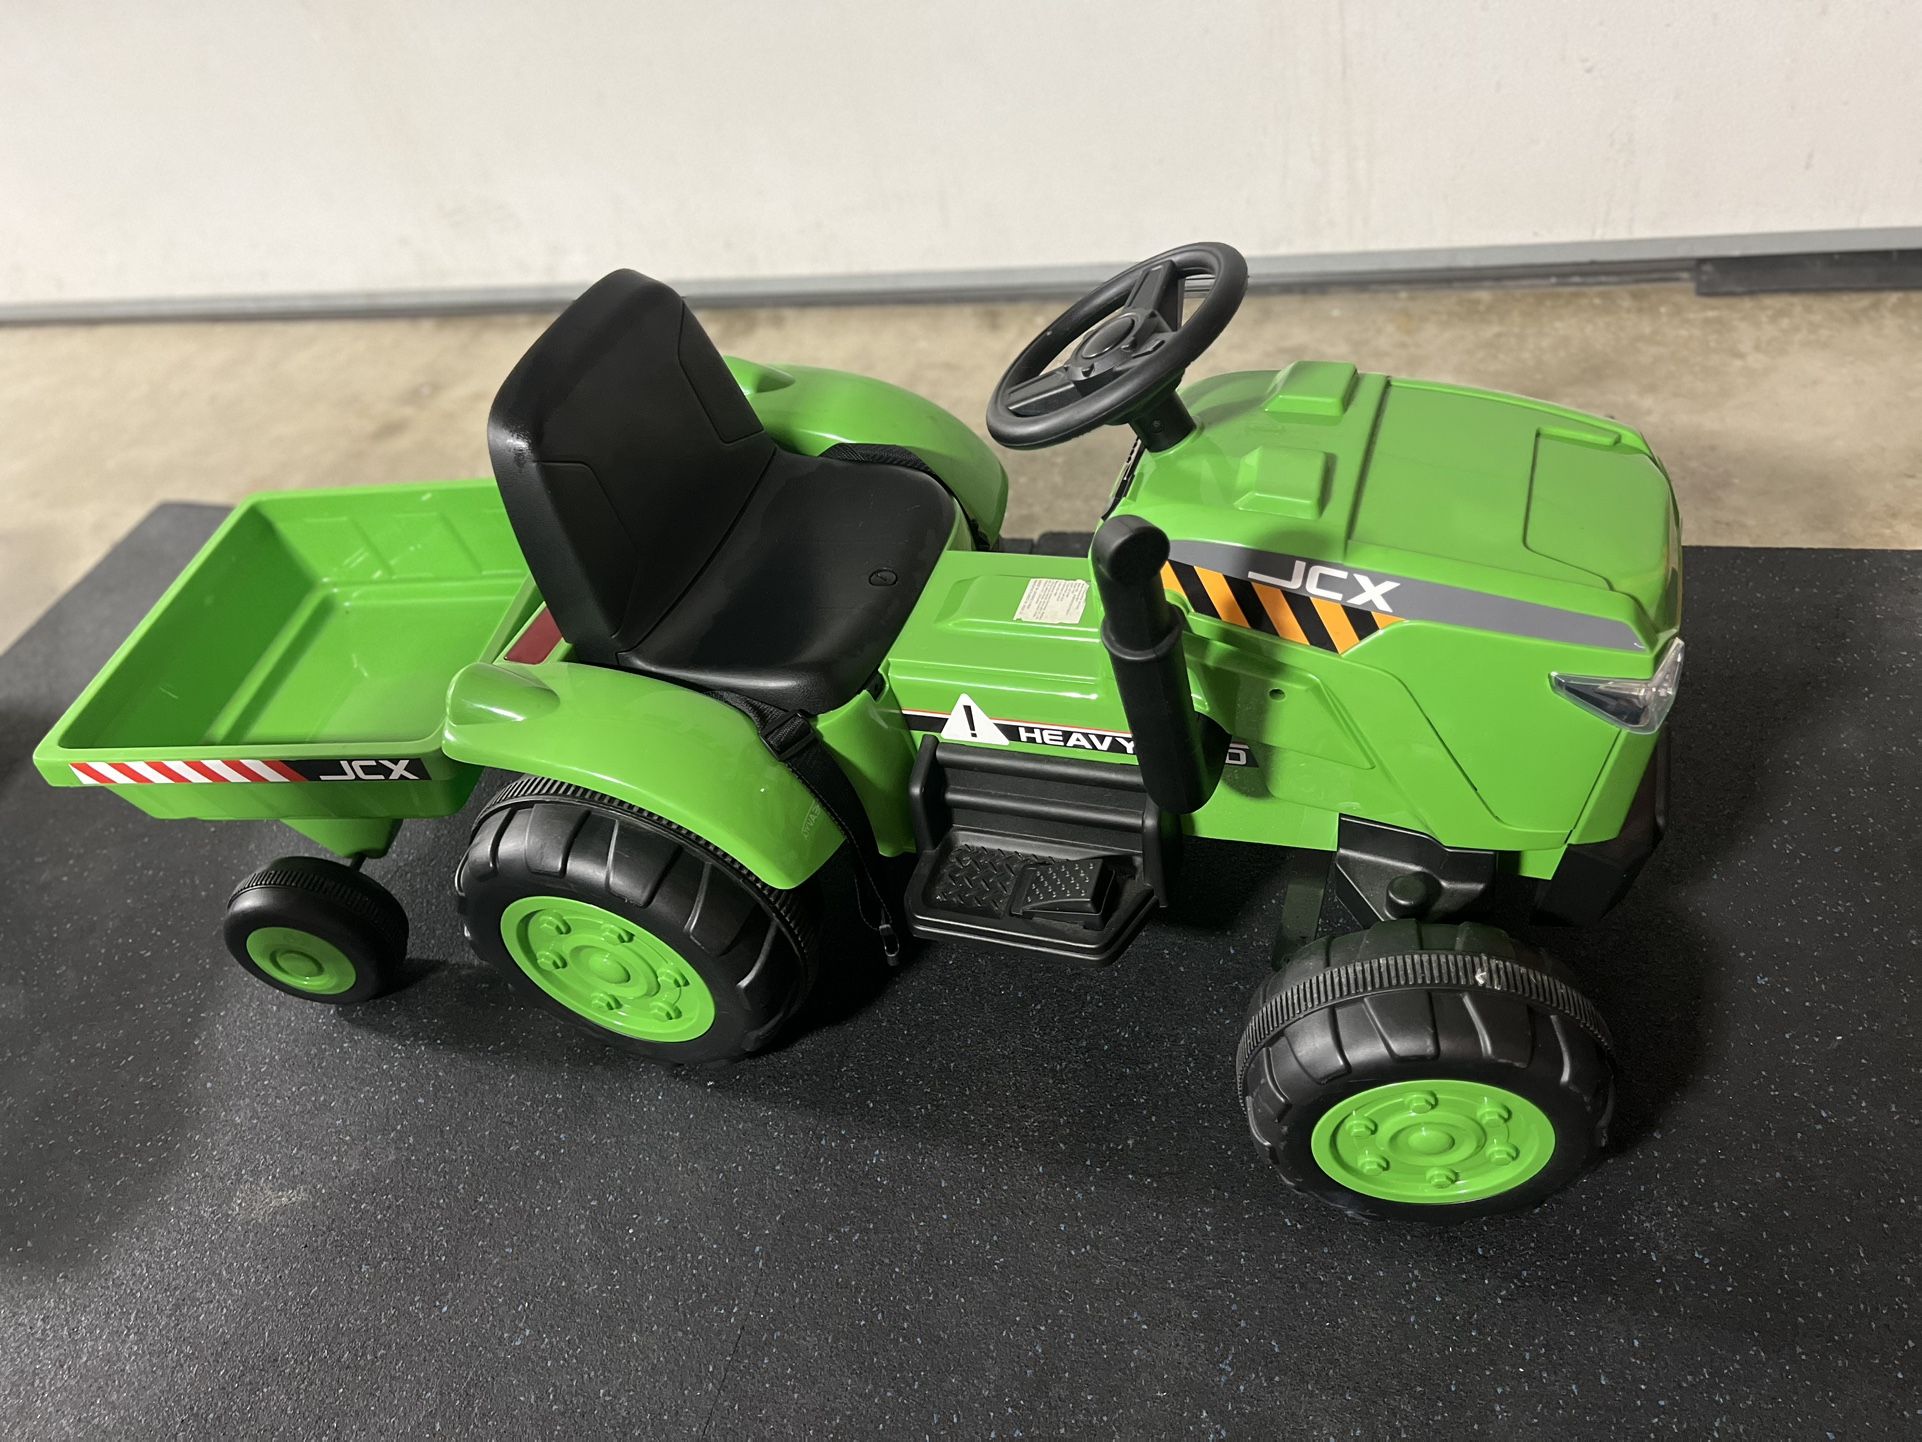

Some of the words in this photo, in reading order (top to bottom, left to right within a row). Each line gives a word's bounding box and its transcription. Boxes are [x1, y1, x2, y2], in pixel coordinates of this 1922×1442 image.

[1247, 559, 1401, 613] JCX
[1018, 726, 1136, 754] HEAVY
[319, 759, 420, 781] JCX
